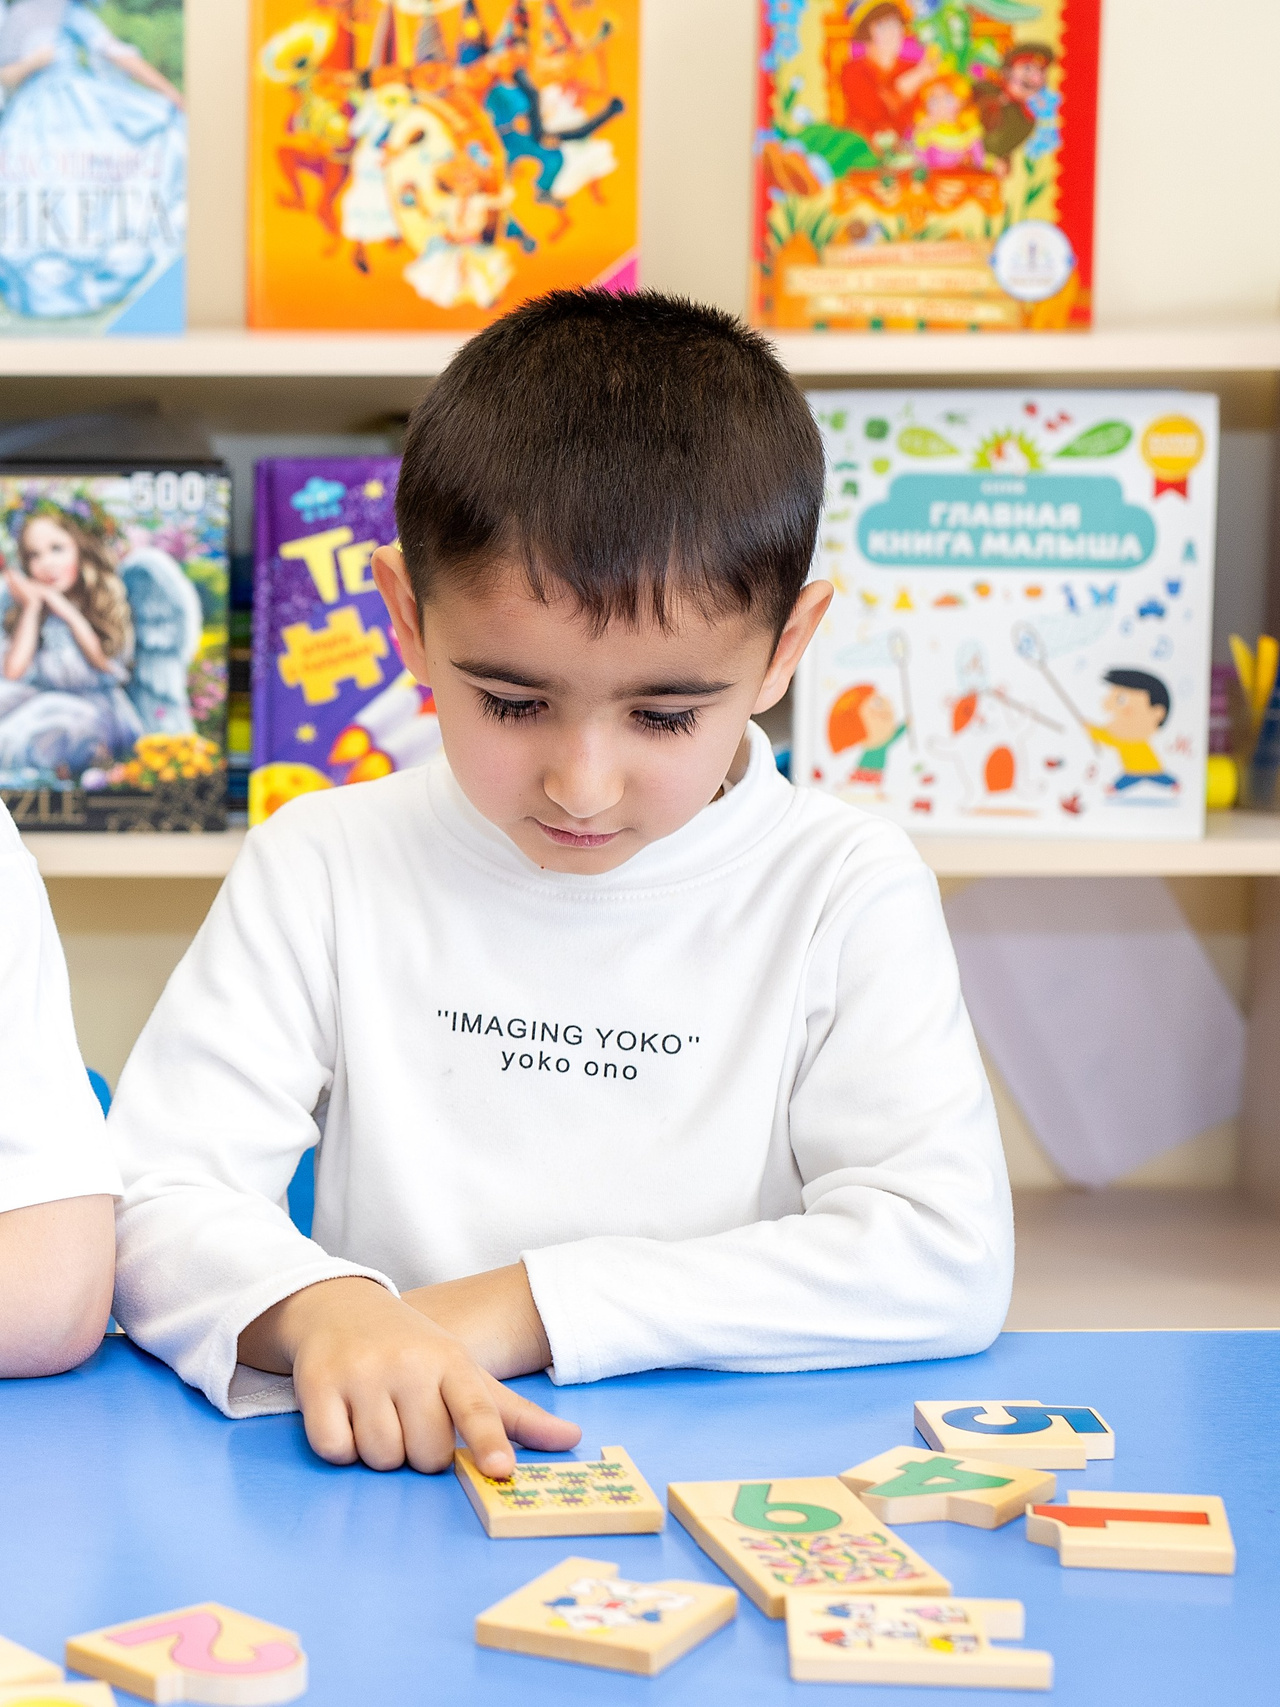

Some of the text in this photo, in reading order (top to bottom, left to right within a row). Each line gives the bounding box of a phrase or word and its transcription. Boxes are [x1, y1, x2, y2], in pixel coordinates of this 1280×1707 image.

[131, 471, 205, 512] 500
[929, 502, 1081, 530] ГЛАВНАЯ
[867, 530, 1143, 561] КНИГА МАЛЫША
[437, 1010, 700, 1055] "IMAGING YOKO"
[501, 1050, 638, 1080] yoko ono
[941, 1405, 1109, 1436] 5
[861, 1456, 1016, 1498] 4
[104, 1611, 301, 1676] 2
